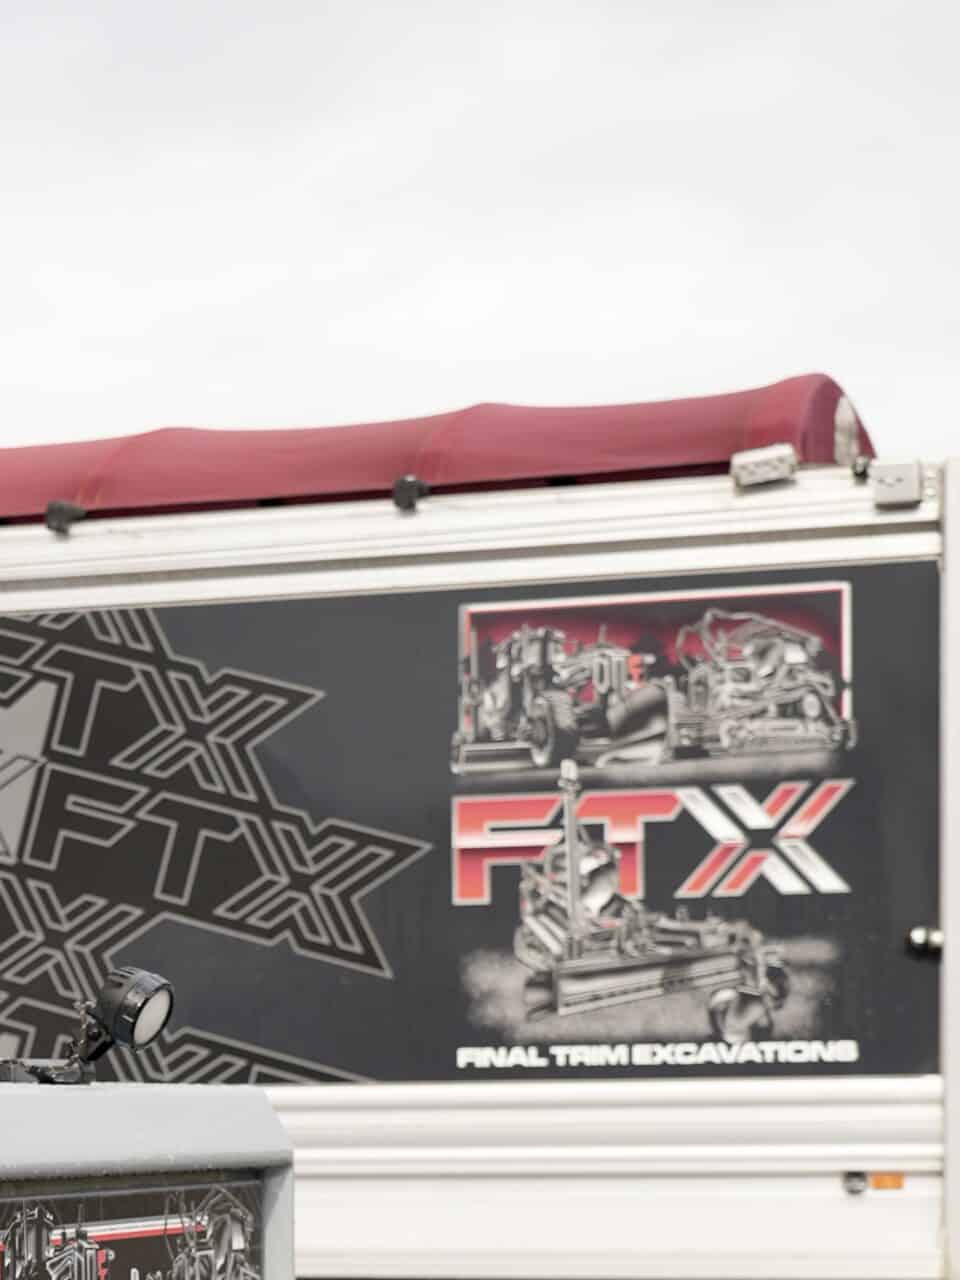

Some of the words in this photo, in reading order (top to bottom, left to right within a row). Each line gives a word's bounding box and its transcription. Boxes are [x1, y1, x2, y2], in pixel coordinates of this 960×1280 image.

[22, 762, 395, 954] FTX
[451, 778, 856, 906] FTX
[456, 1046, 548, 1068] FINAL
[549, 1043, 630, 1067] TRIM
[632, 1040, 859, 1065] EXCAVATIONS
